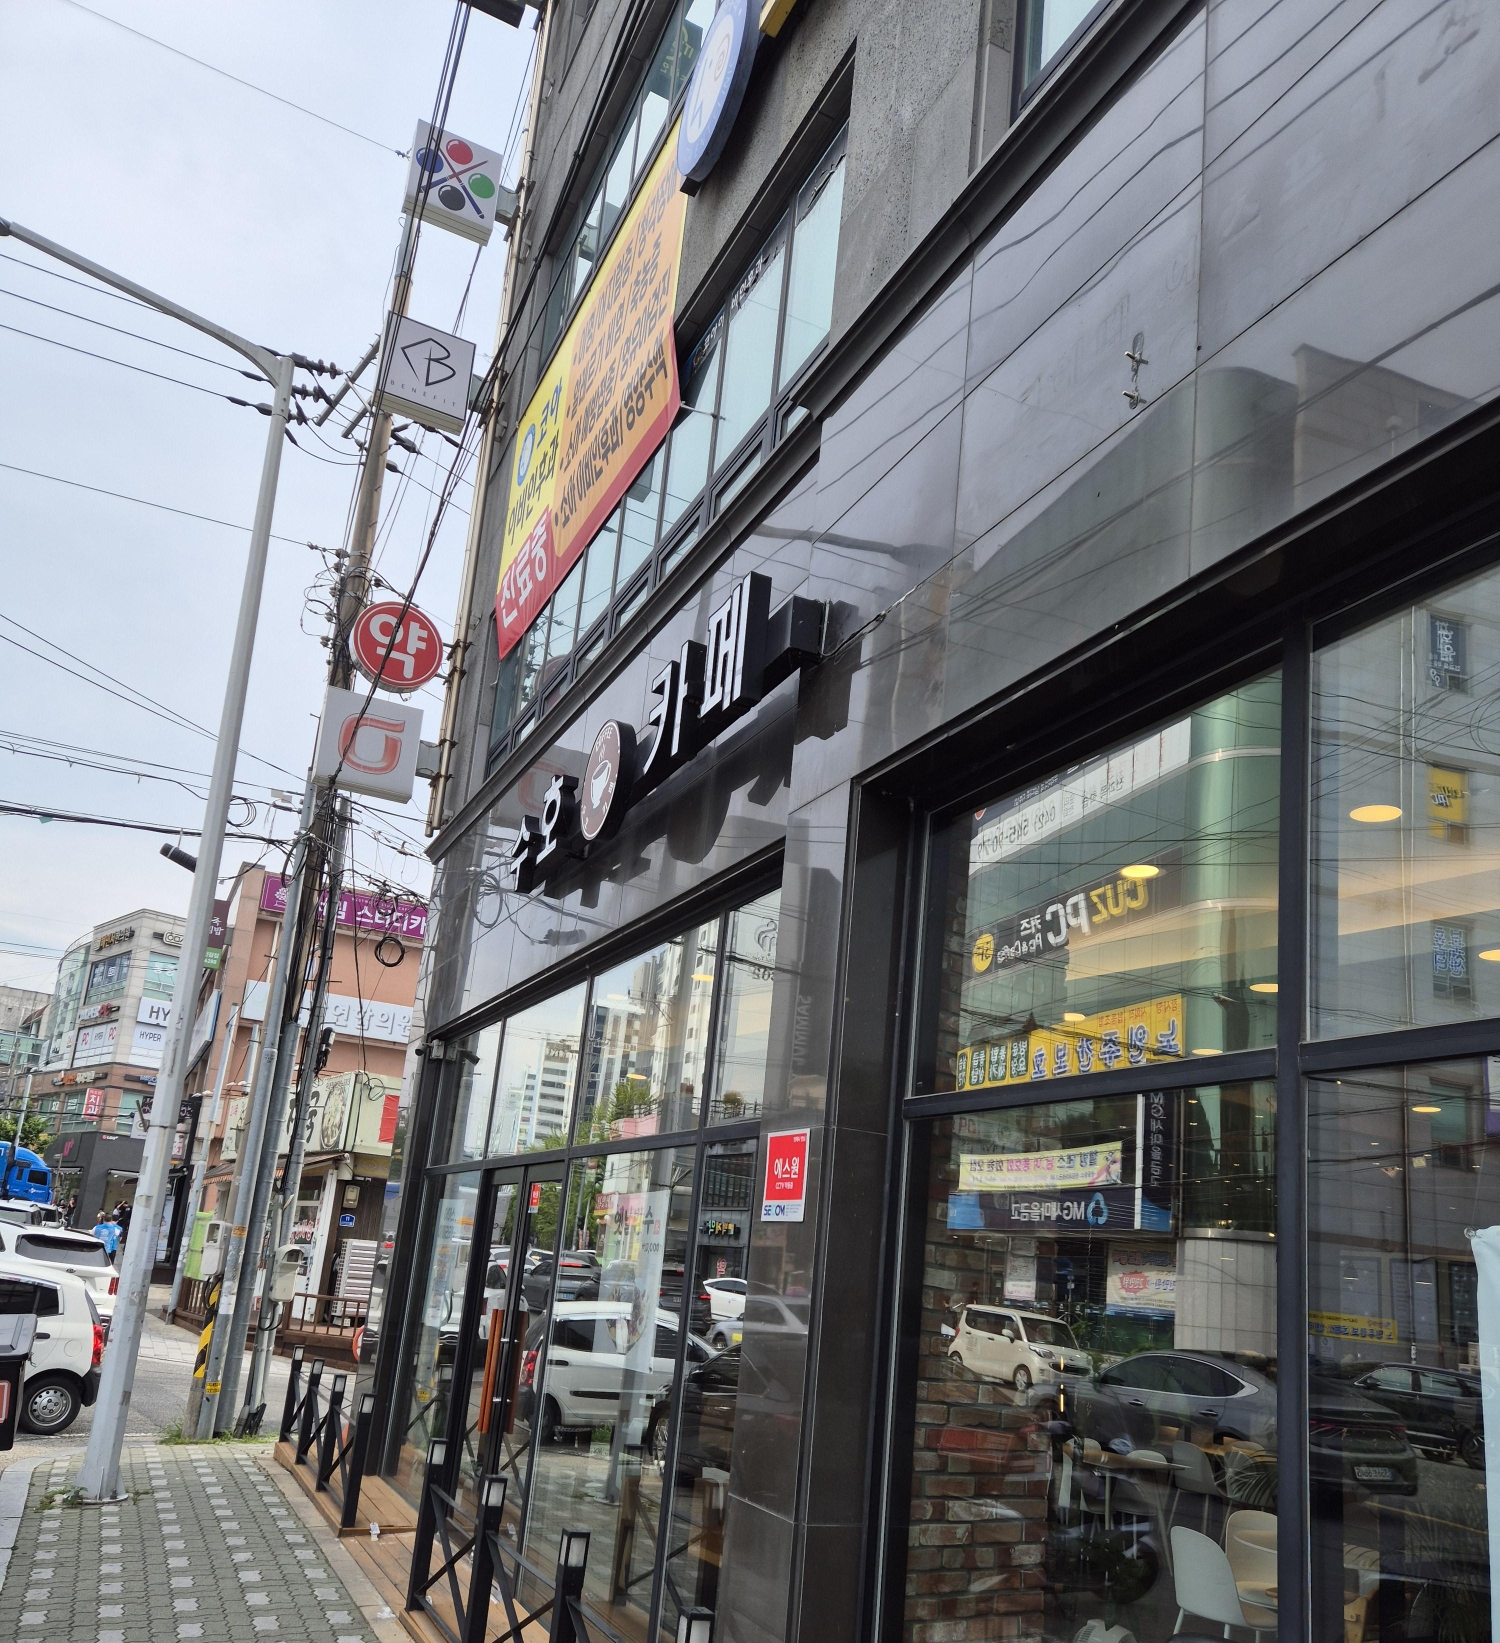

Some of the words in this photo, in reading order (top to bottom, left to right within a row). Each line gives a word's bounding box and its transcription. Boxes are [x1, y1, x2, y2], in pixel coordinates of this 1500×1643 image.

[389, 379, 458, 409] BENEFIT
[536, 375, 563, 450] 코아
[571, 351, 607, 421] 알레르기
[508, 428, 560, 546] 이비인후과
[499, 511, 549, 629] 진료중
[368, 612, 431, 682] 약
[642, 570, 754, 776] 카페
[139, 1030, 162, 1043] HYPER
[87, 1093, 100, 1116] 치과
[773, 1156, 800, 1179] 에스원
